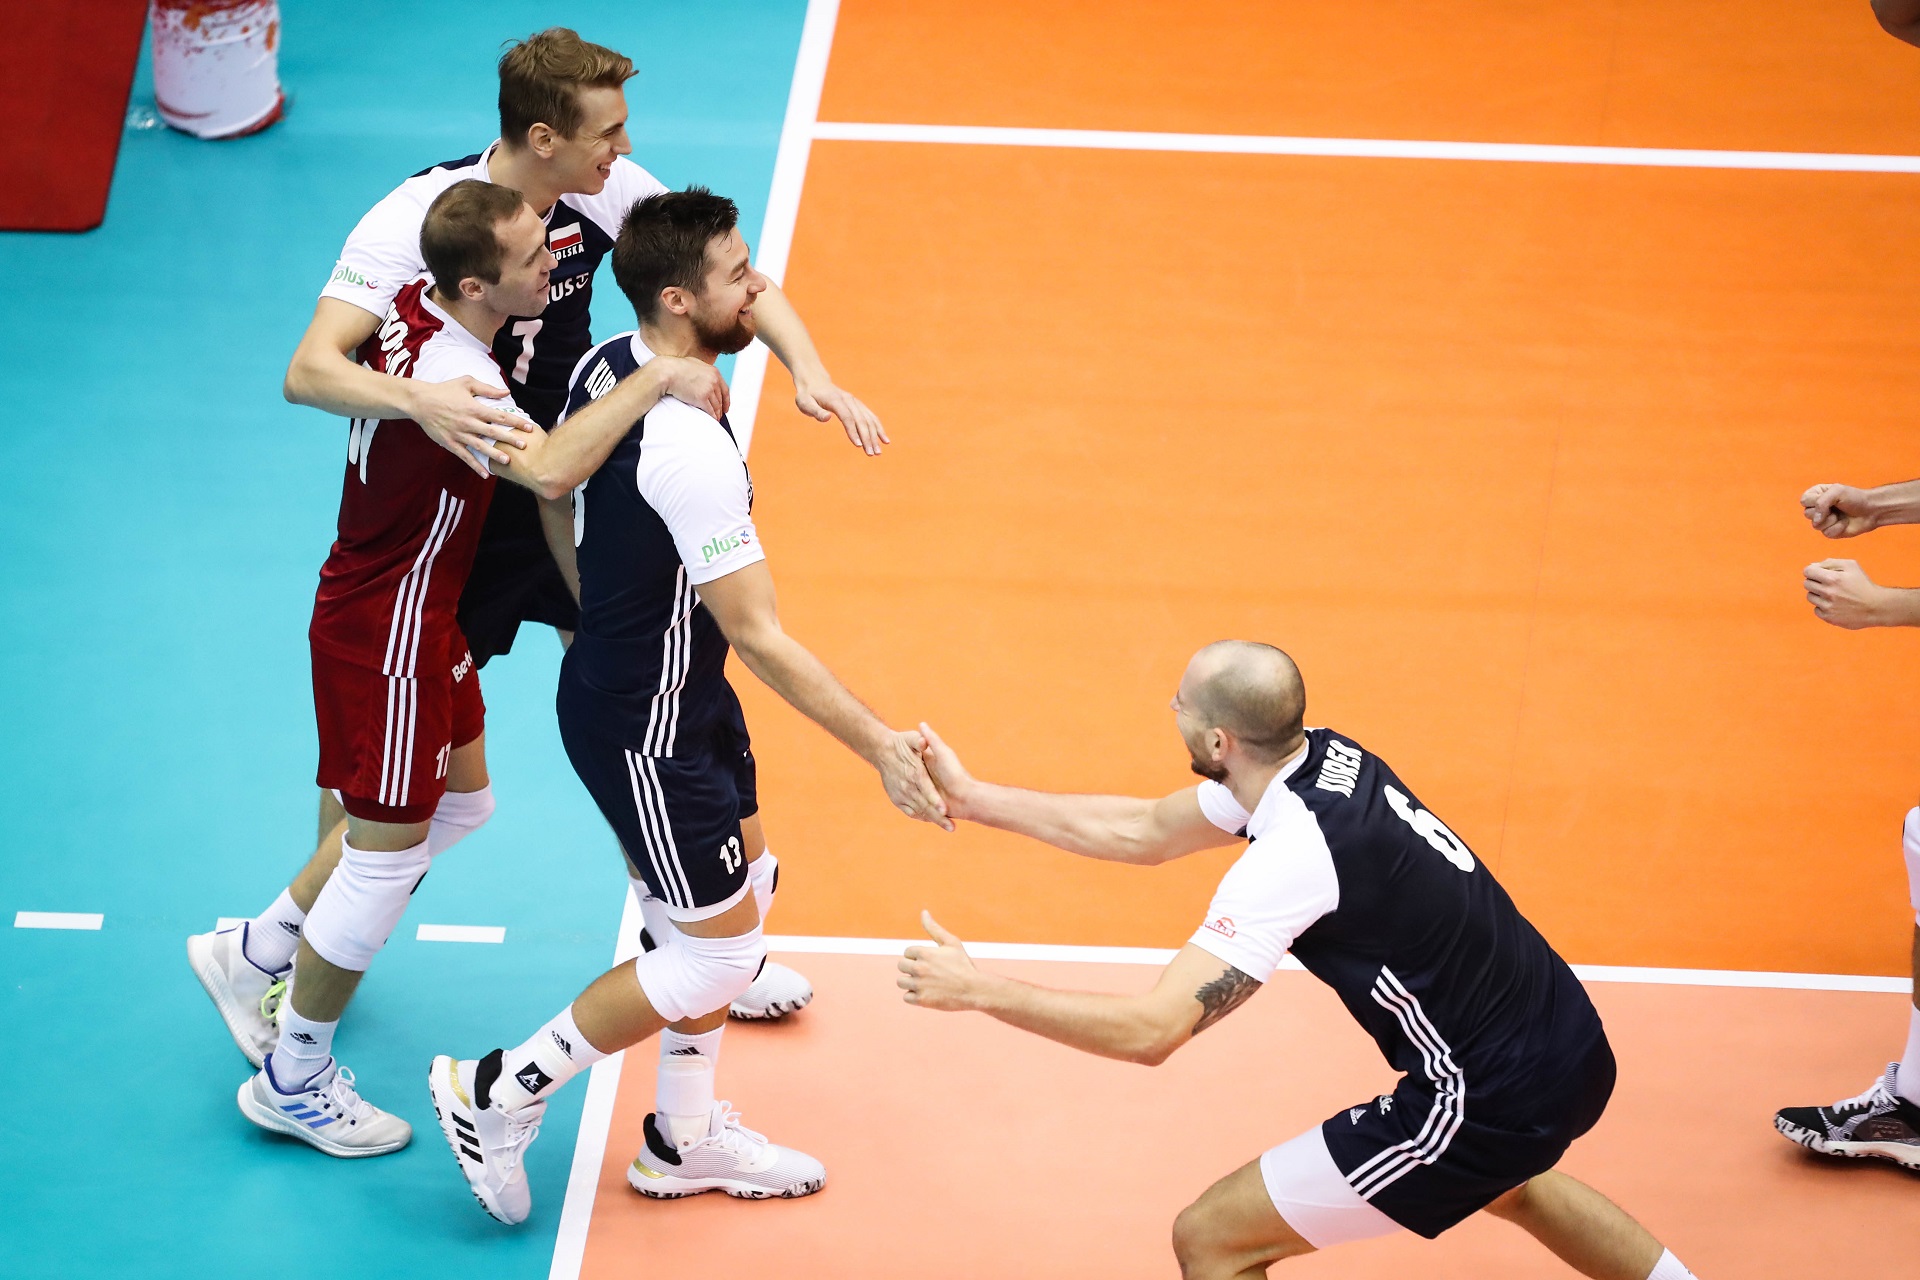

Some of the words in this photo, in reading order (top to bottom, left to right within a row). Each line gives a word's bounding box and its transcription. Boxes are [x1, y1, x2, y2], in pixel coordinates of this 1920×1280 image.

[332, 265, 366, 286] plus
[511, 318, 543, 385] 7
[701, 535, 741, 564] plus
[1315, 739, 1363, 799] KUREK
[1383, 784, 1475, 874] 6
[719, 835, 742, 875] 13
